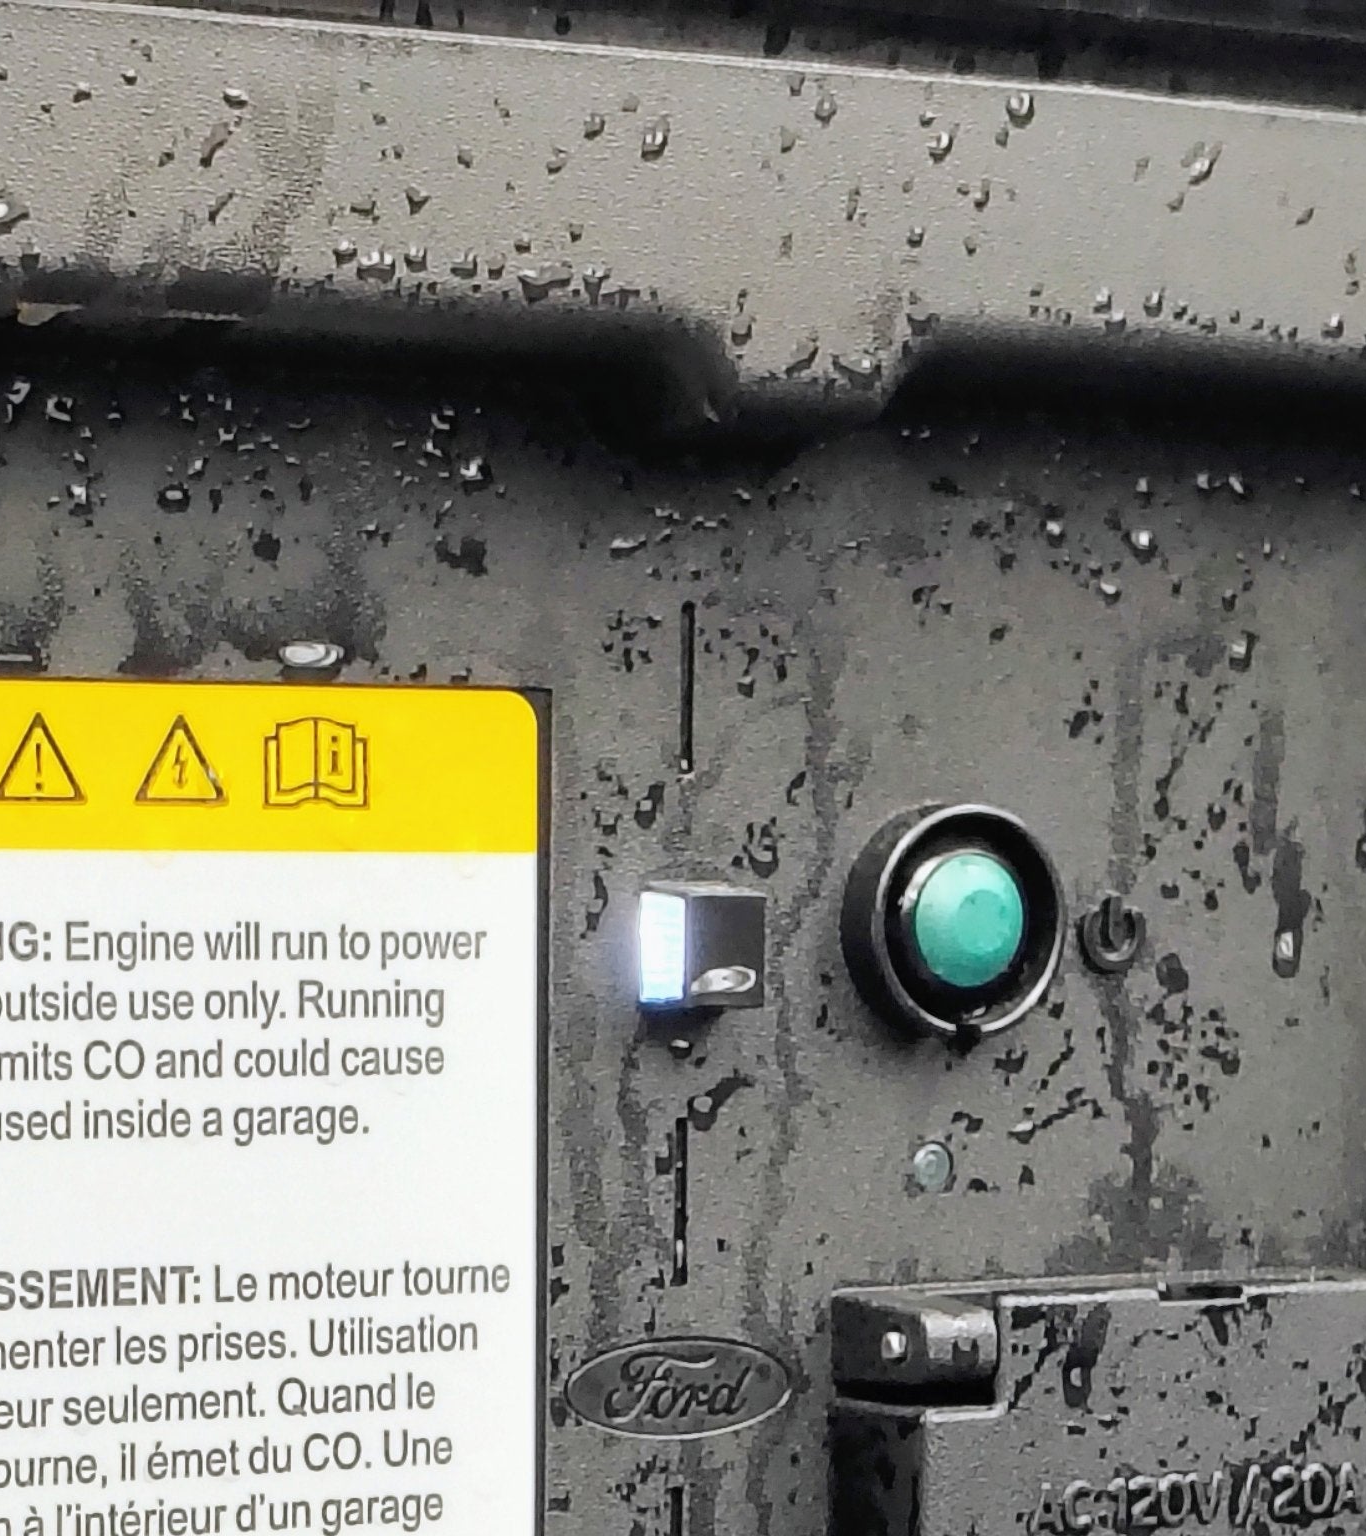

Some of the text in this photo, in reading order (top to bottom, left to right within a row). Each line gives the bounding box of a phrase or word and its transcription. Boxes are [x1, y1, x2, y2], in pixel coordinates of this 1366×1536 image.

[66, 921, 194, 971] Engine
[204, 921, 260, 960] will
[272, 931, 327, 960] run
[339, 924, 370, 960] to
[381, 931, 487, 970] power
[129, 990, 194, 1020] use
[205, 980, 286, 1029] only.
[299, 979, 444, 1028] Running
[84, 1039, 145, 1080] CO
[156, 1039, 222, 1079] and
[234, 1038, 329, 1078] could
[341, 1047, 444, 1076] cause
[84, 1099, 191, 1139] inside
[203, 1107, 222, 1137] a
[233, 1105, 369, 1146] garage.
[215, 1265, 257, 1302] Le
[269, 1263, 394, 1301] moteur
[403, 1260, 509, 1296] tourne
[116, 1326, 166, 1365] les
[179, 1322, 296, 1373] prises.
[310, 1314, 477, 1357] Utilisation
[63, 1382, 265, 1426] seulement.
[278, 1373, 395, 1417] Quand
[407, 1372, 435, 1409] le
[604, 1351, 752, 1423] Ford
[121, 1443, 135, 1481] il
[148, 1440, 240, 1480] émet
[248, 1436, 291, 1474] du
[303, 1432, 371, 1472] CO.
[384, 1429, 452, 1467] Une
[236, 1494, 311, 1532] d'un
[322, 1493, 443, 1536] garage
